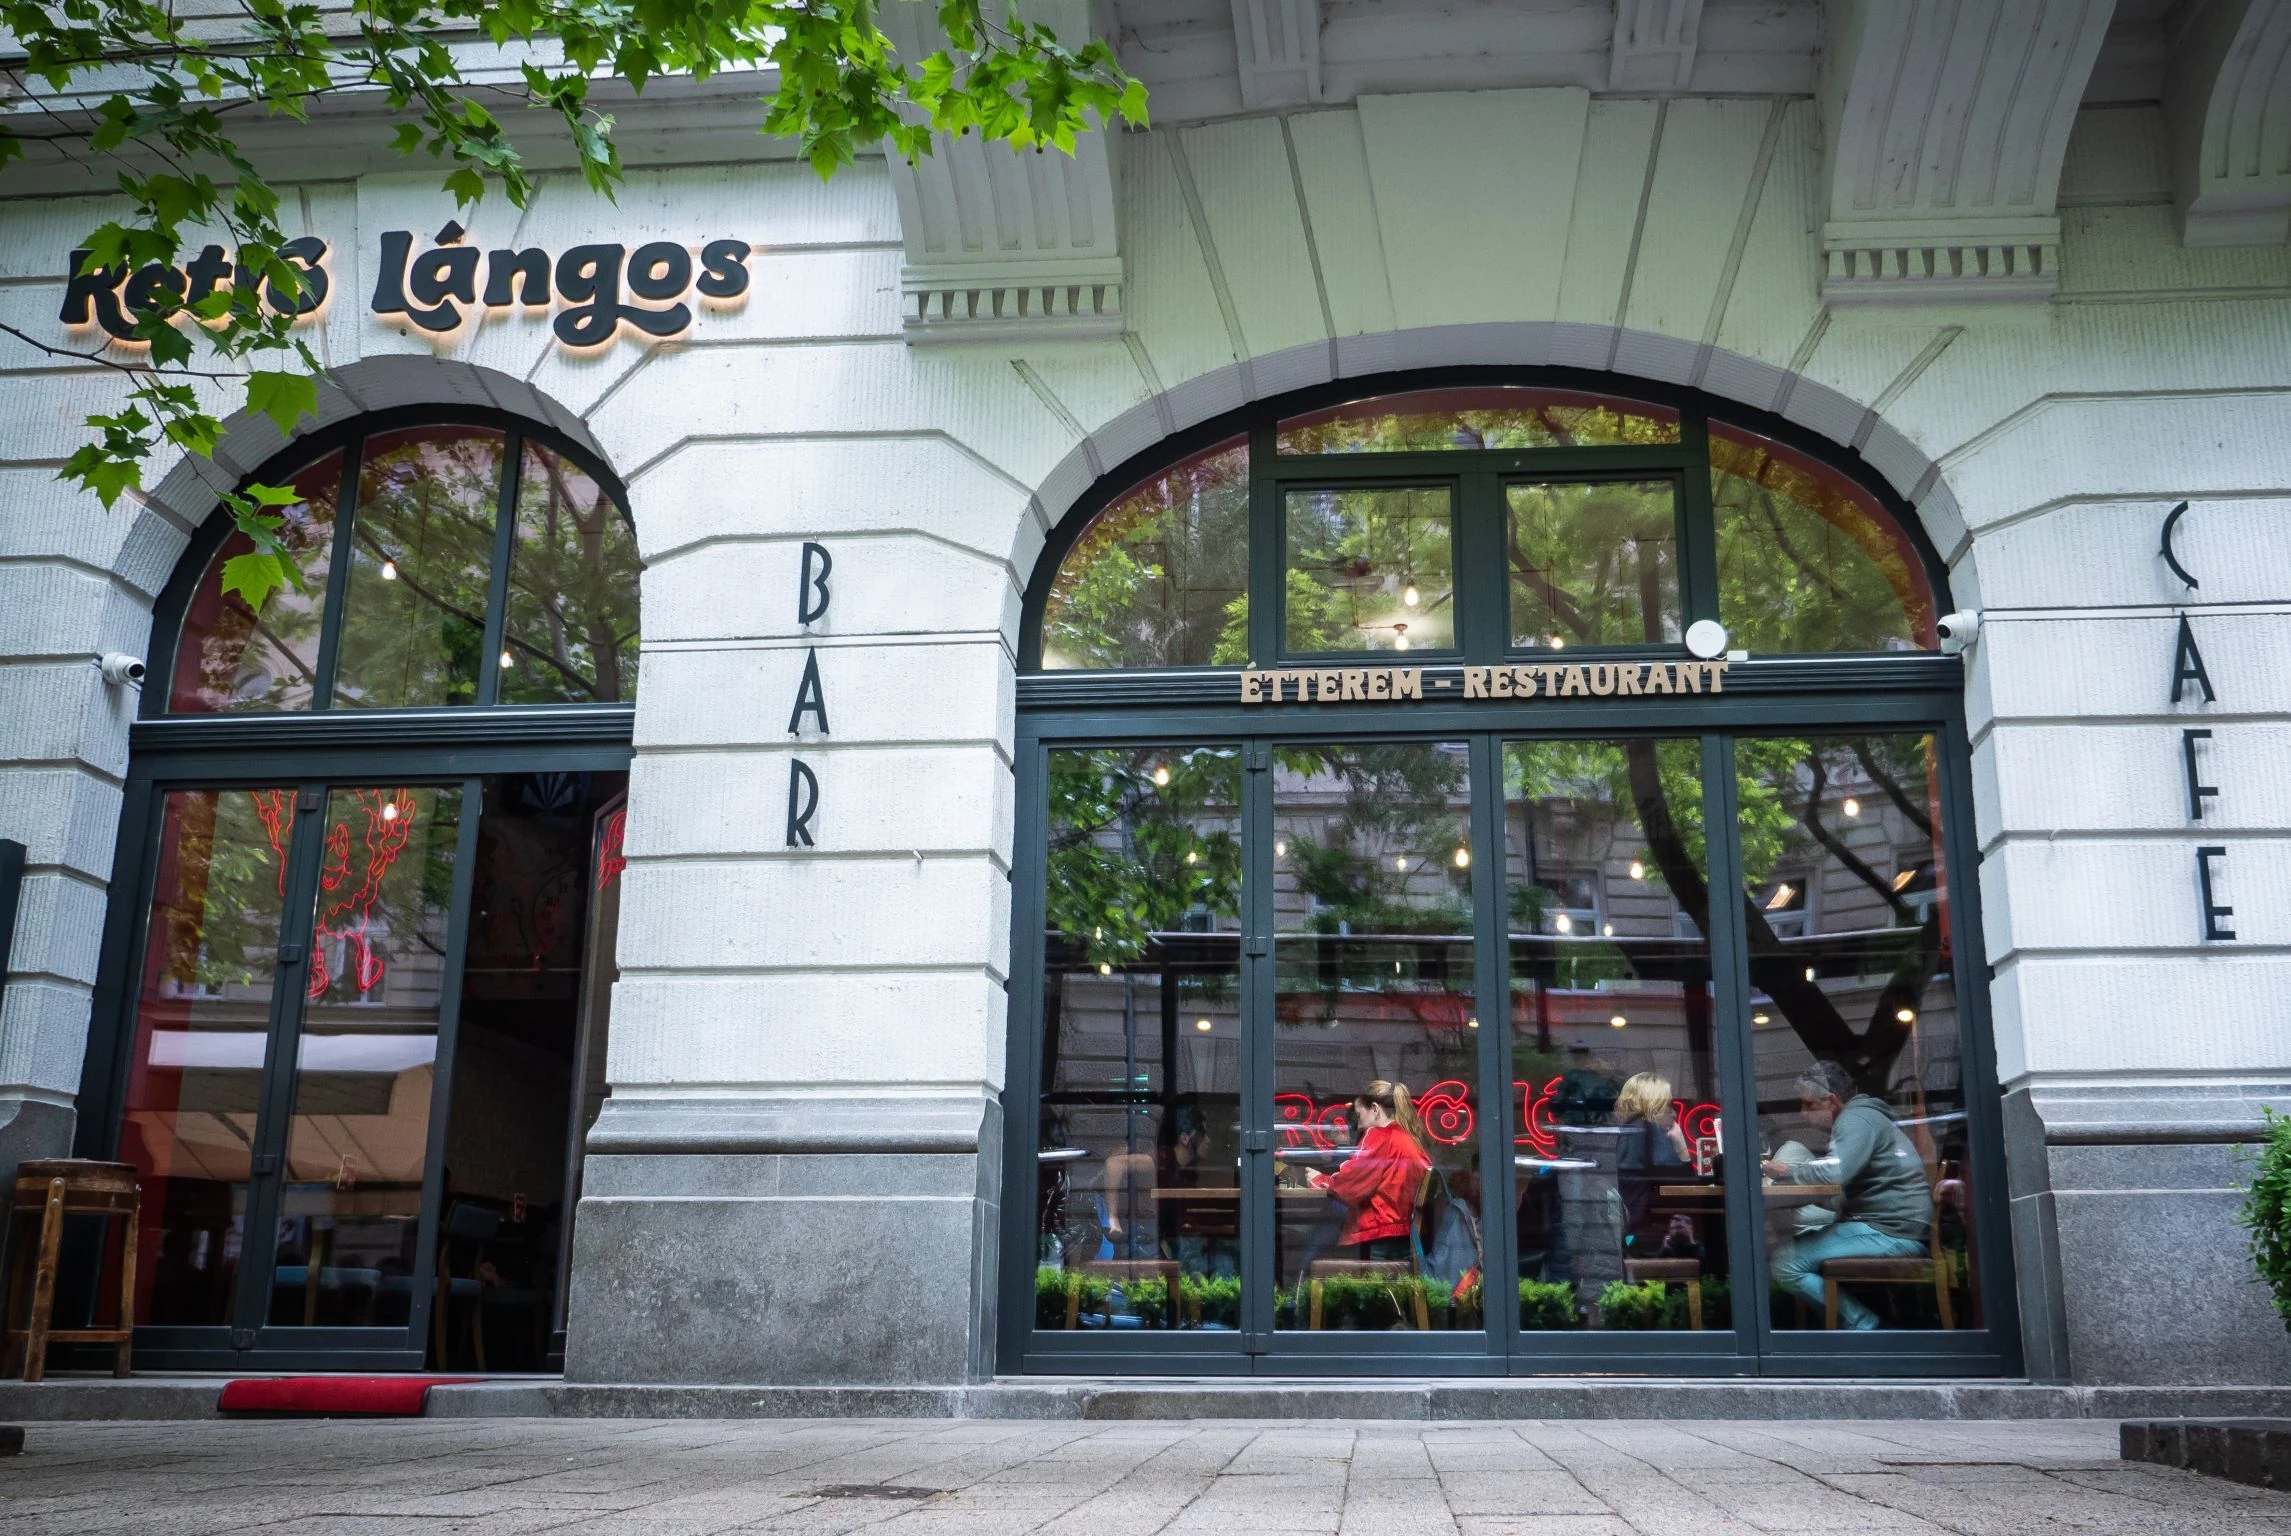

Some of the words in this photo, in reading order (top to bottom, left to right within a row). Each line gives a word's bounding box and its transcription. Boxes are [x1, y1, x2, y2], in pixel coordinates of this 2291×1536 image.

[371, 219, 751, 347] Lángos
[786, 542, 832, 847] BAR
[1463, 661, 1729, 699] RESTAURANT
[2160, 499, 2237, 940] CAFE
